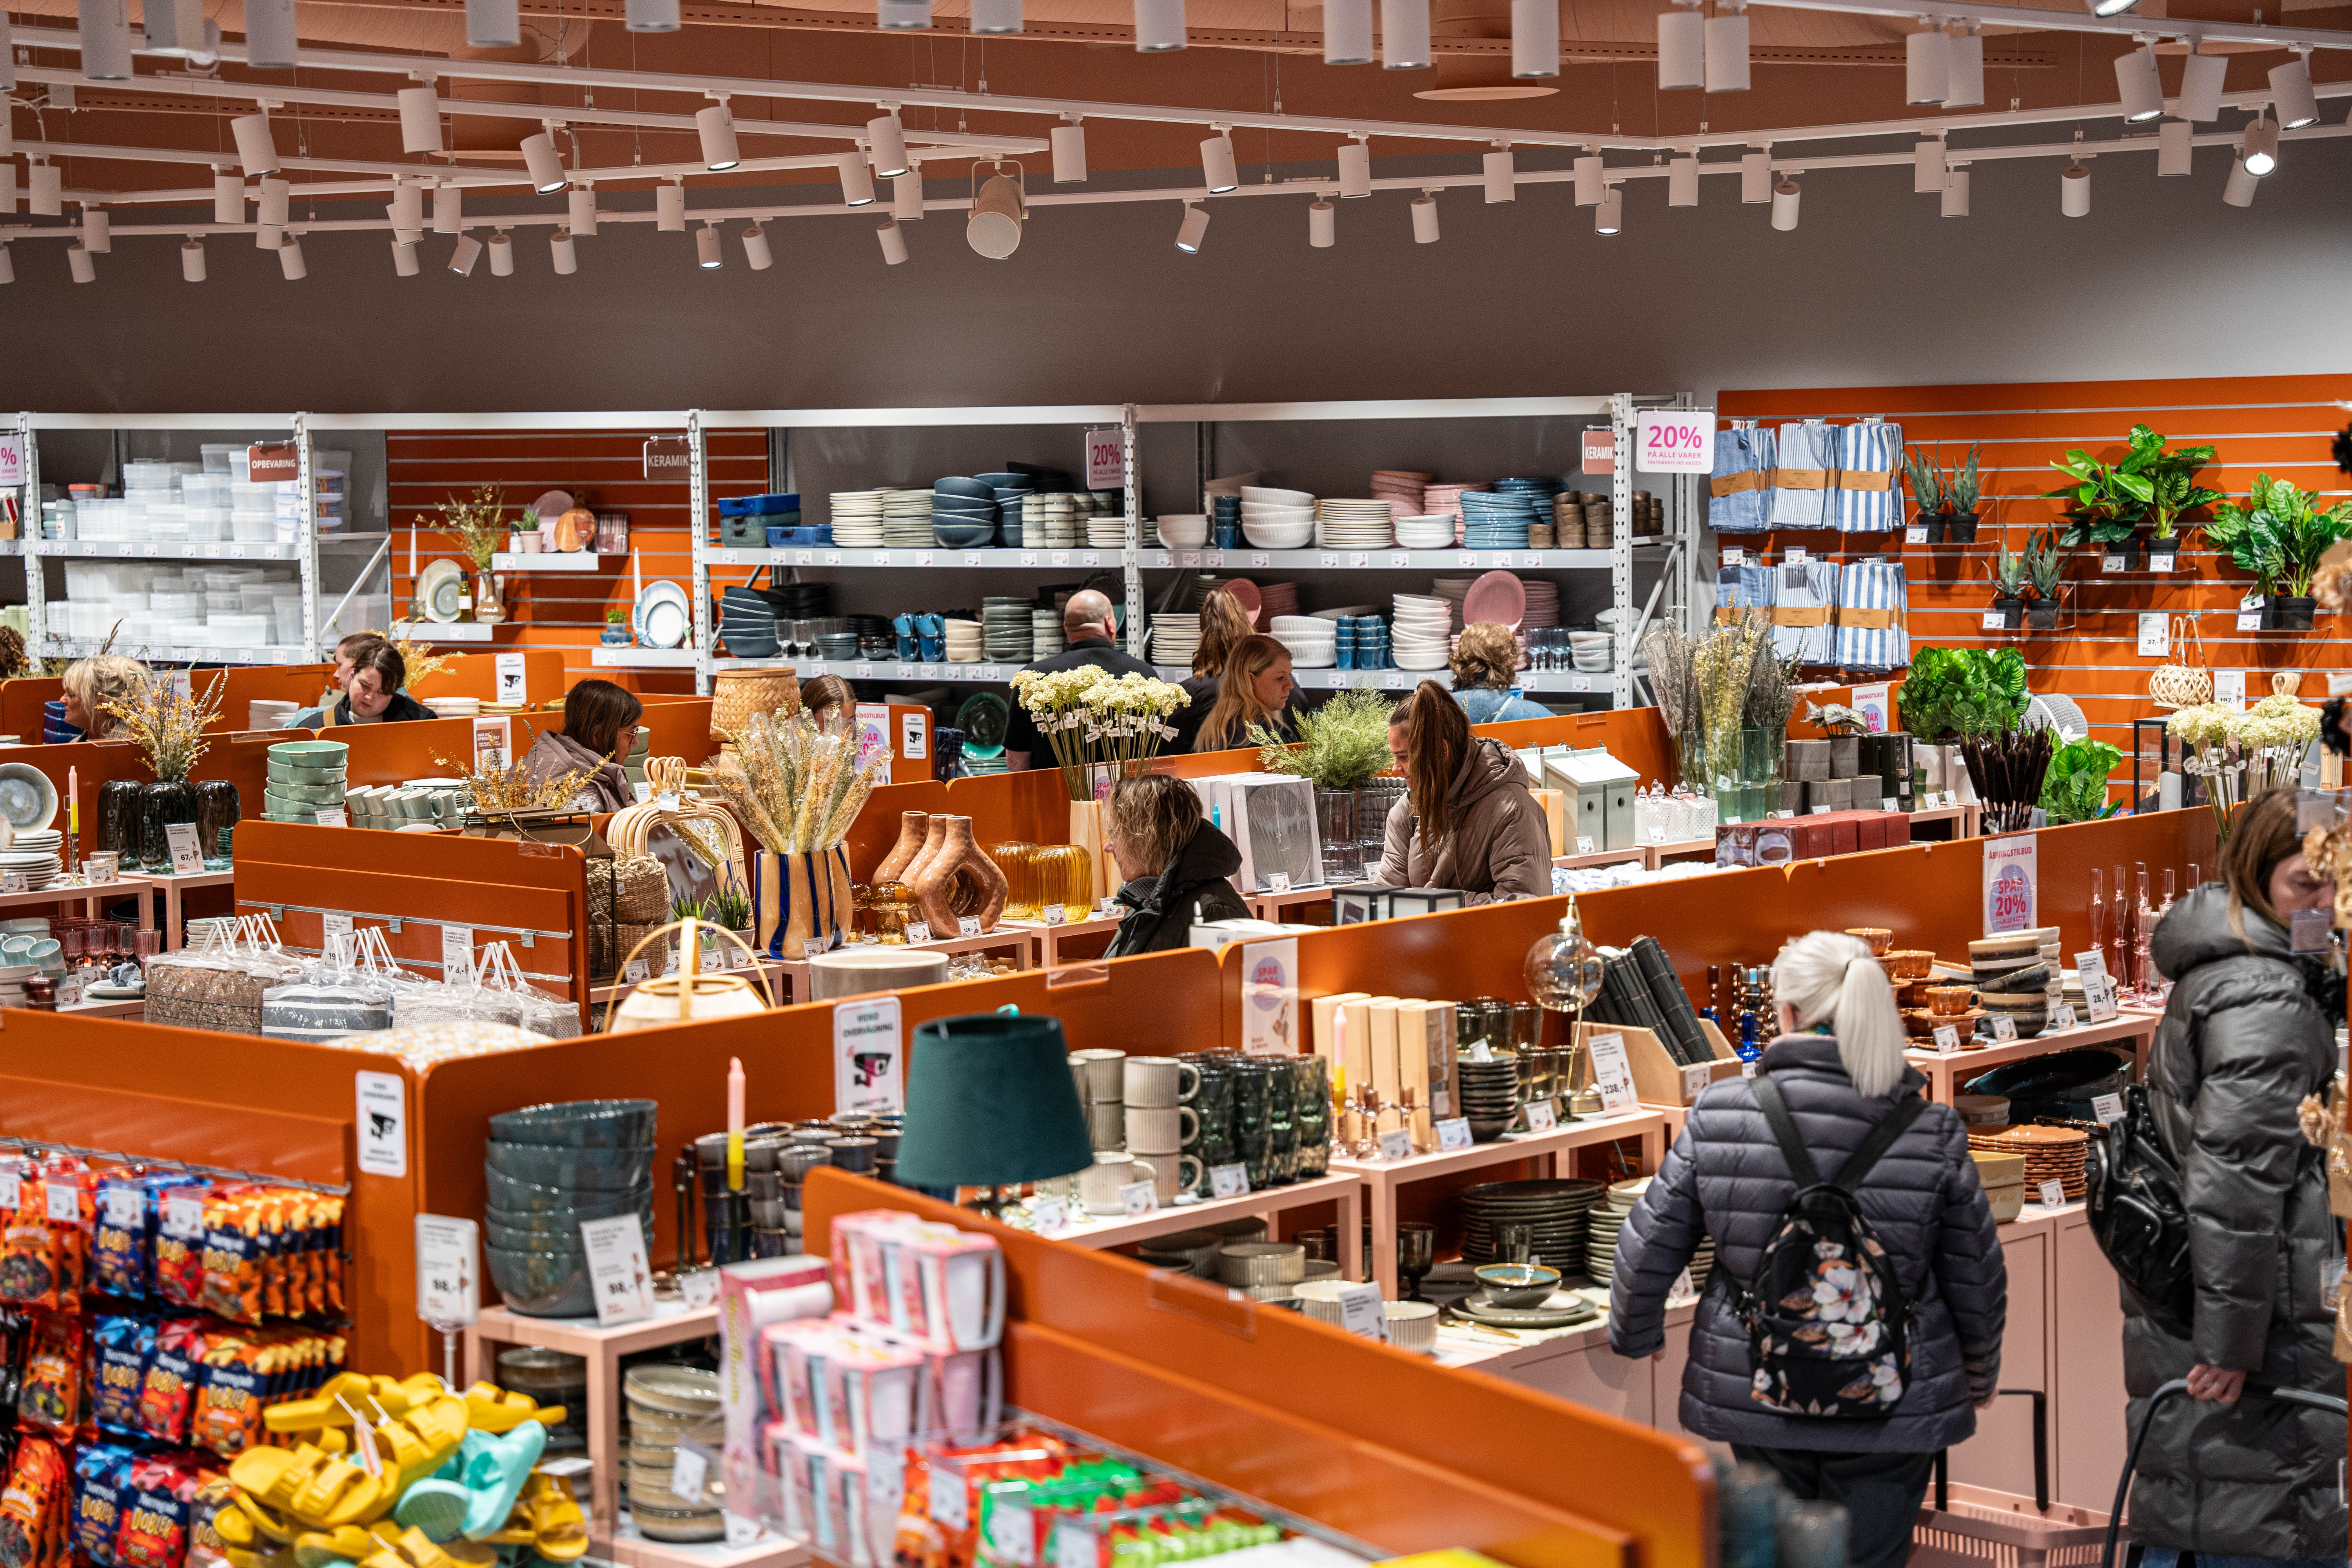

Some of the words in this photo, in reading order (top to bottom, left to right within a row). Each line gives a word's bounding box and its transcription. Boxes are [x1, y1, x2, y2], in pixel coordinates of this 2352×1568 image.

[1648, 425, 1702, 448] 20%
[1094, 444, 1120, 466] 20%
[1585, 446, 1614, 459] KERAMIK
[252, 459, 296, 469] OPBEVARING
[648, 455, 689, 467] KERAMIK
[1855, 692, 1885, 701] ÅBNINGSTILBUD
[1867, 713, 1878, 722] PAR
[1989, 846, 2033, 860] ÅBNINGSTILBUD
[1998, 878, 2023, 895] SPAR
[1995, 893, 2027, 918] 20%
[2093, 994, 2105, 1004] 28,-
[1604, 1084, 1624, 1094] 238,-
